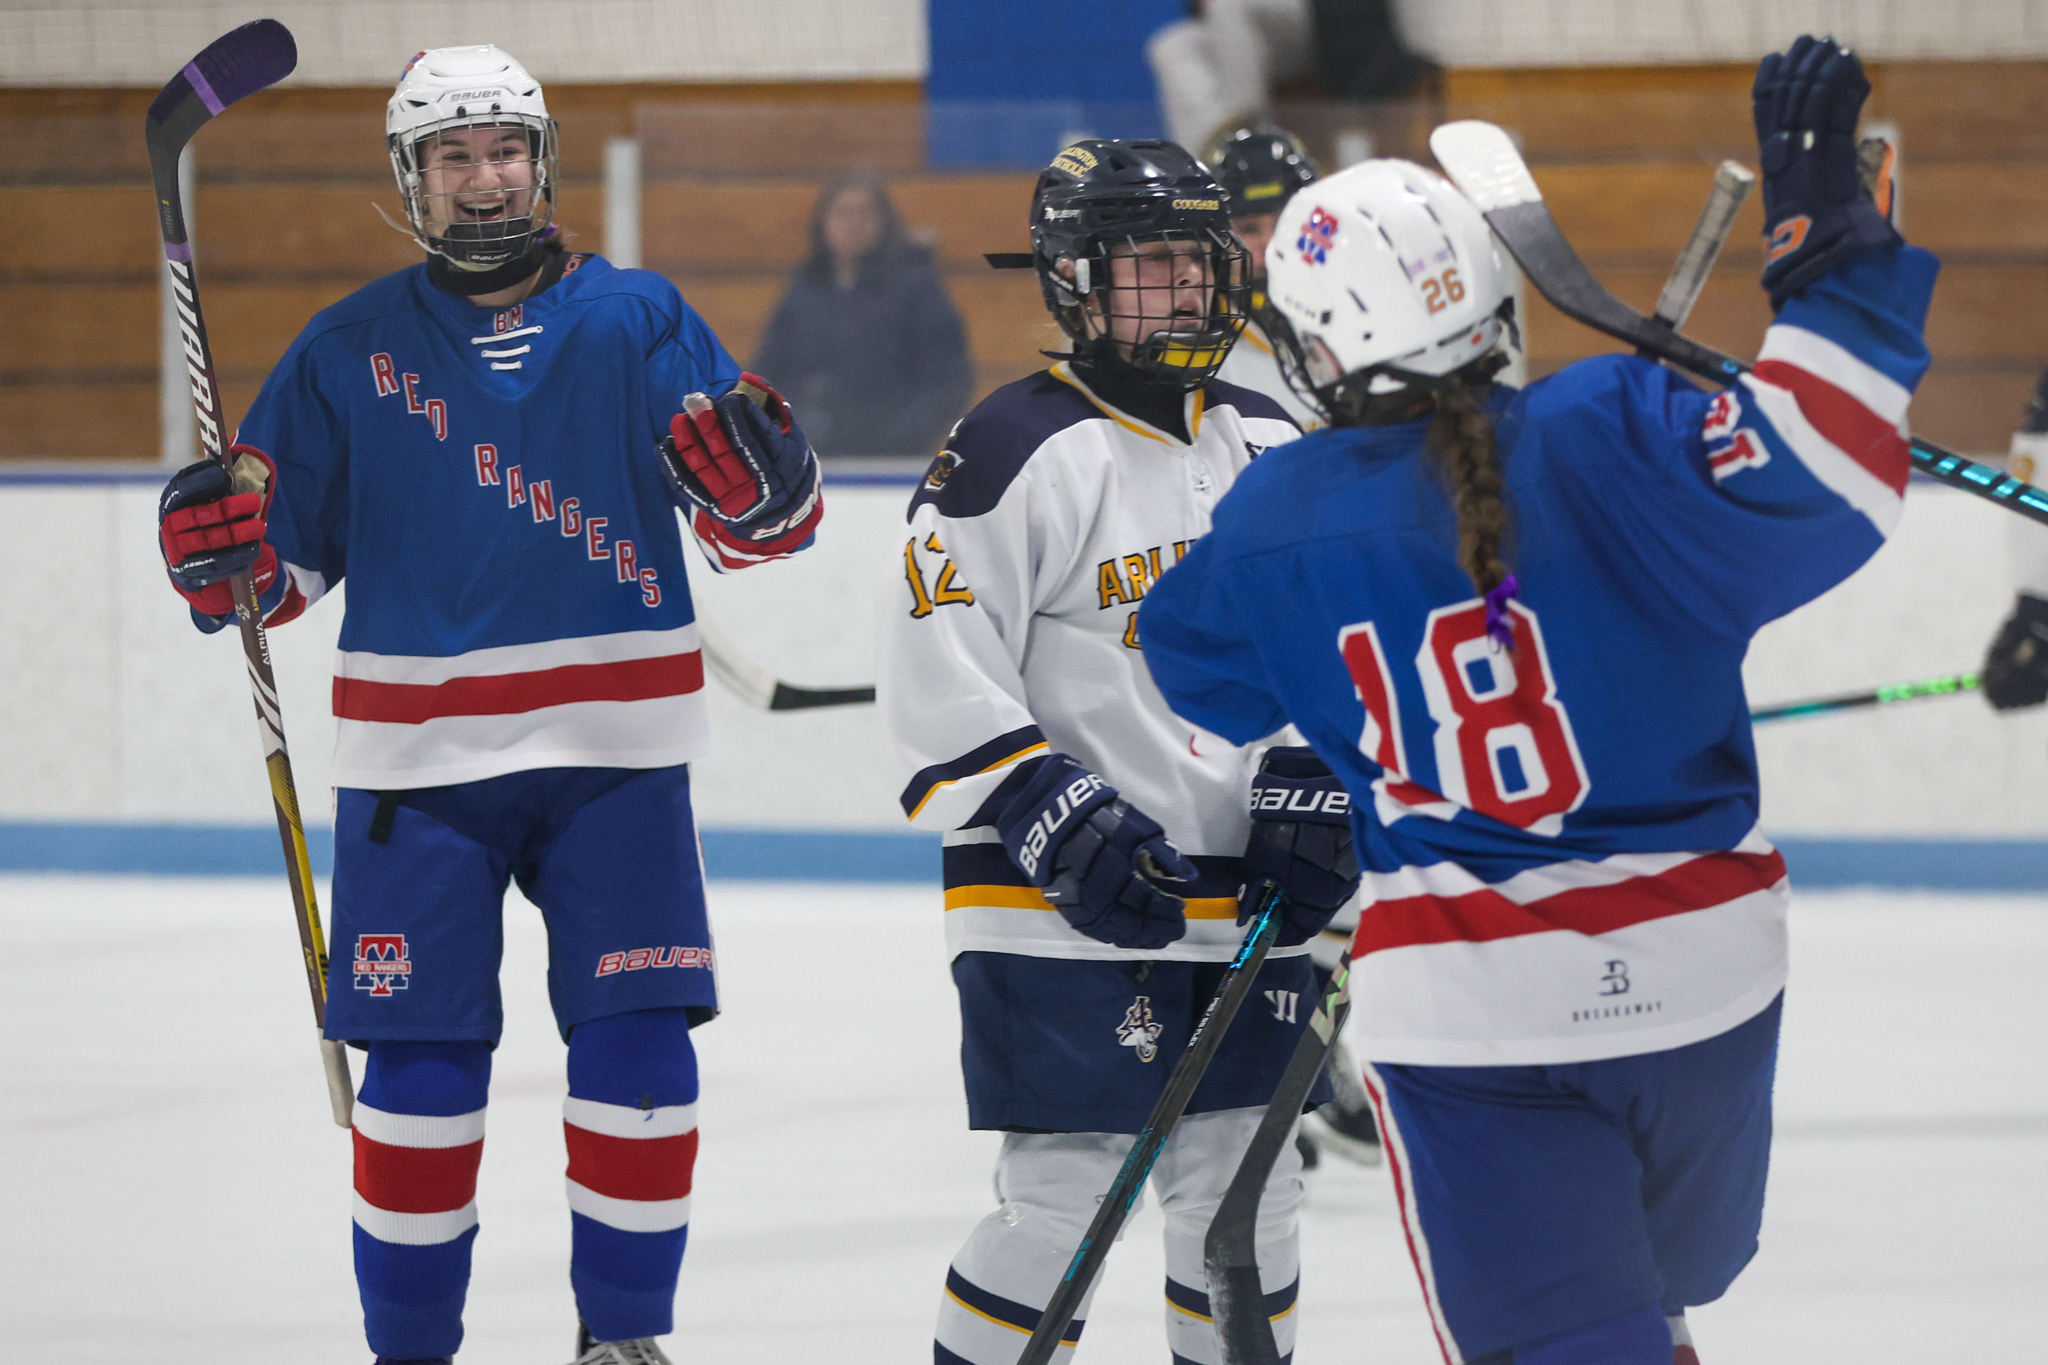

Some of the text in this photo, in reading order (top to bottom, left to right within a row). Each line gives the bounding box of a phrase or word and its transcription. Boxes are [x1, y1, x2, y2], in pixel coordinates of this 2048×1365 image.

[450, 90, 503, 102] BAUER
[1420, 267, 1465, 315] 26
[494, 305, 523, 333] BM
[370, 352, 447, 441] RED
[474, 443, 662, 607] RANGERS
[904, 531, 974, 619] 12
[256, 622, 271, 666] ALPHA
[1337, 597, 1592, 837] 18
[1251, 788, 1352, 815] BAUE
[1018, 773, 1110, 877] BAUER
[595, 946, 713, 978] BAUER
